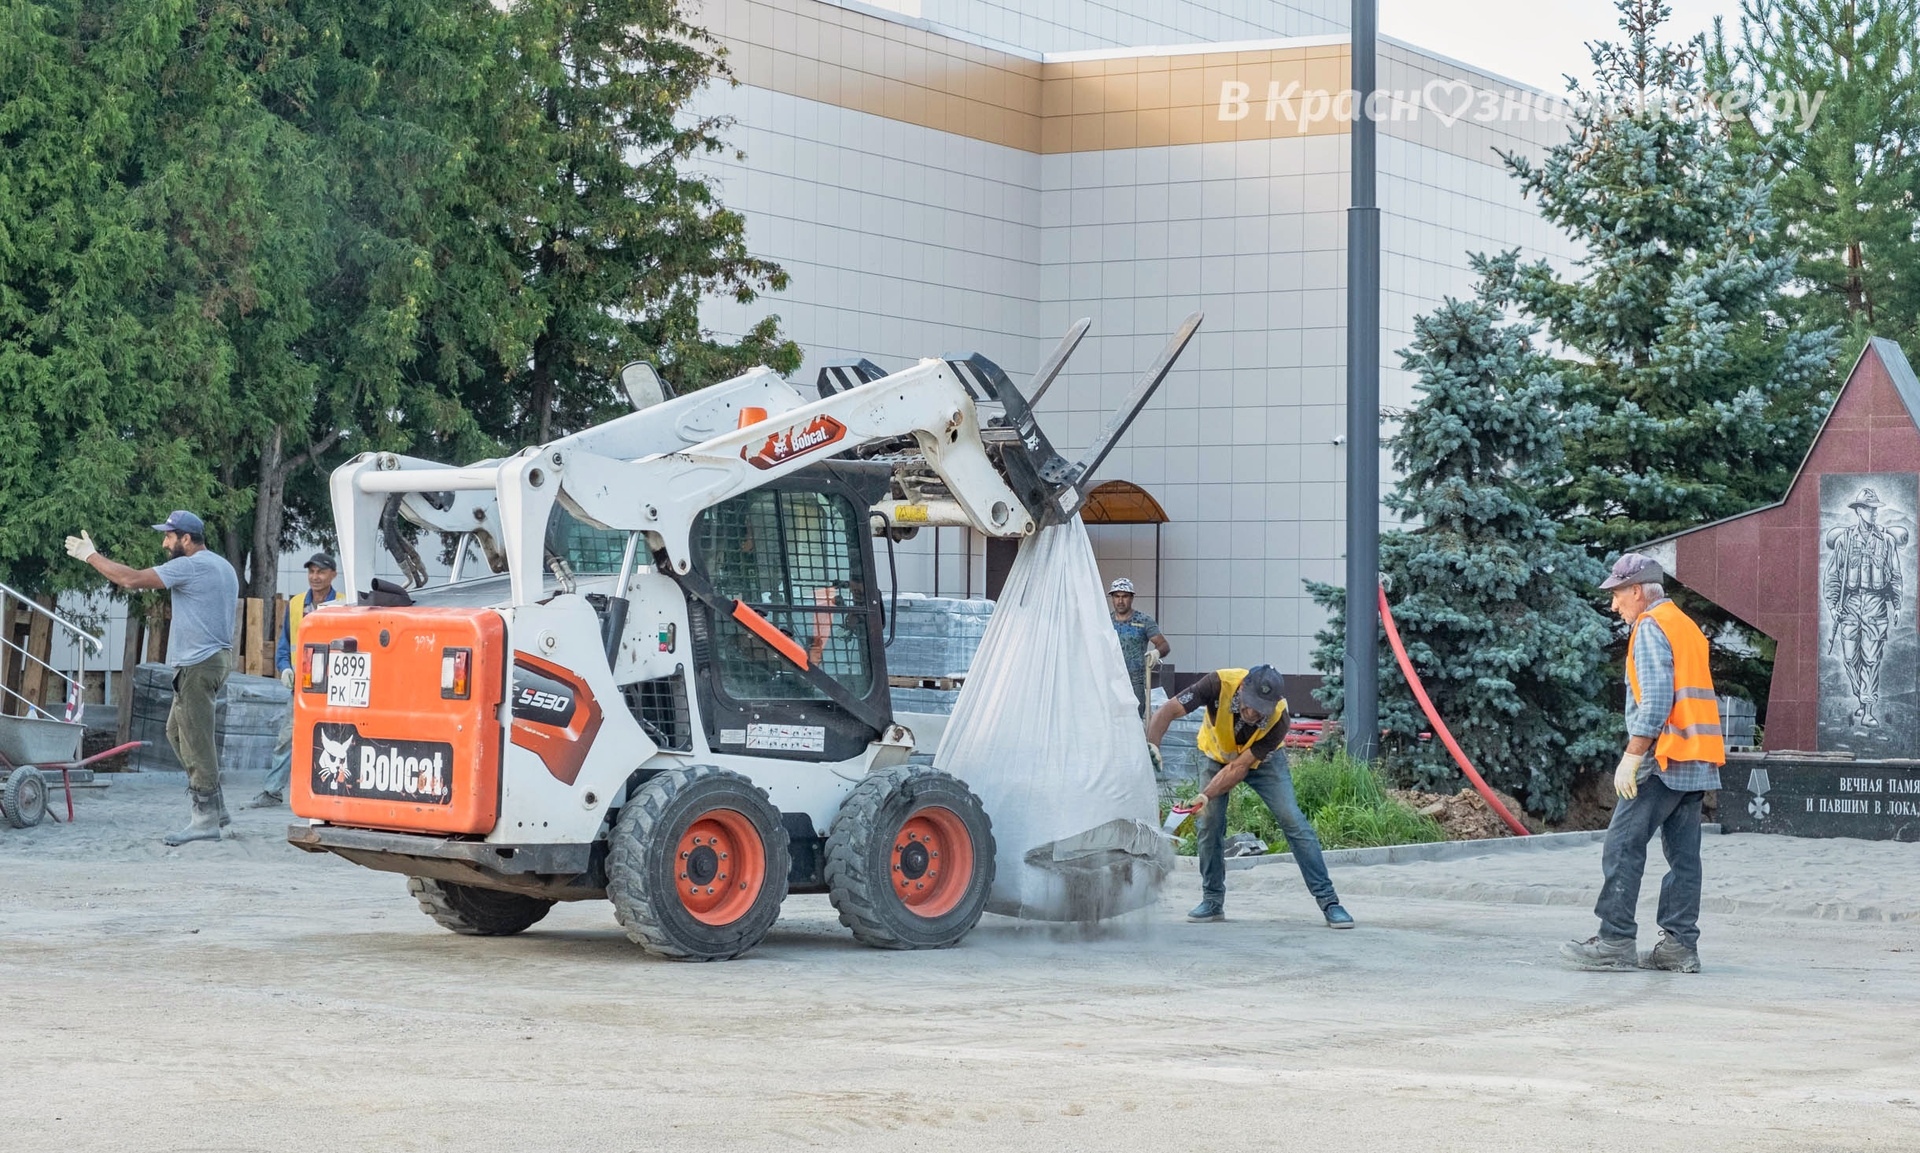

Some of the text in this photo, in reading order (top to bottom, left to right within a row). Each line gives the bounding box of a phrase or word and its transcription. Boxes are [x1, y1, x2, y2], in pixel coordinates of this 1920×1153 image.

[792, 426, 828, 452] Bobcat
[334, 655, 366, 677] 6899
[354, 681, 366, 698] 77
[518, 688, 570, 712] S530
[360, 745, 444, 796] Bobcat
[1840, 777, 1883, 793] ВЕЧНАЯ
[1806, 798, 1920, 818] И ПАВШИМ В ЛОКА
